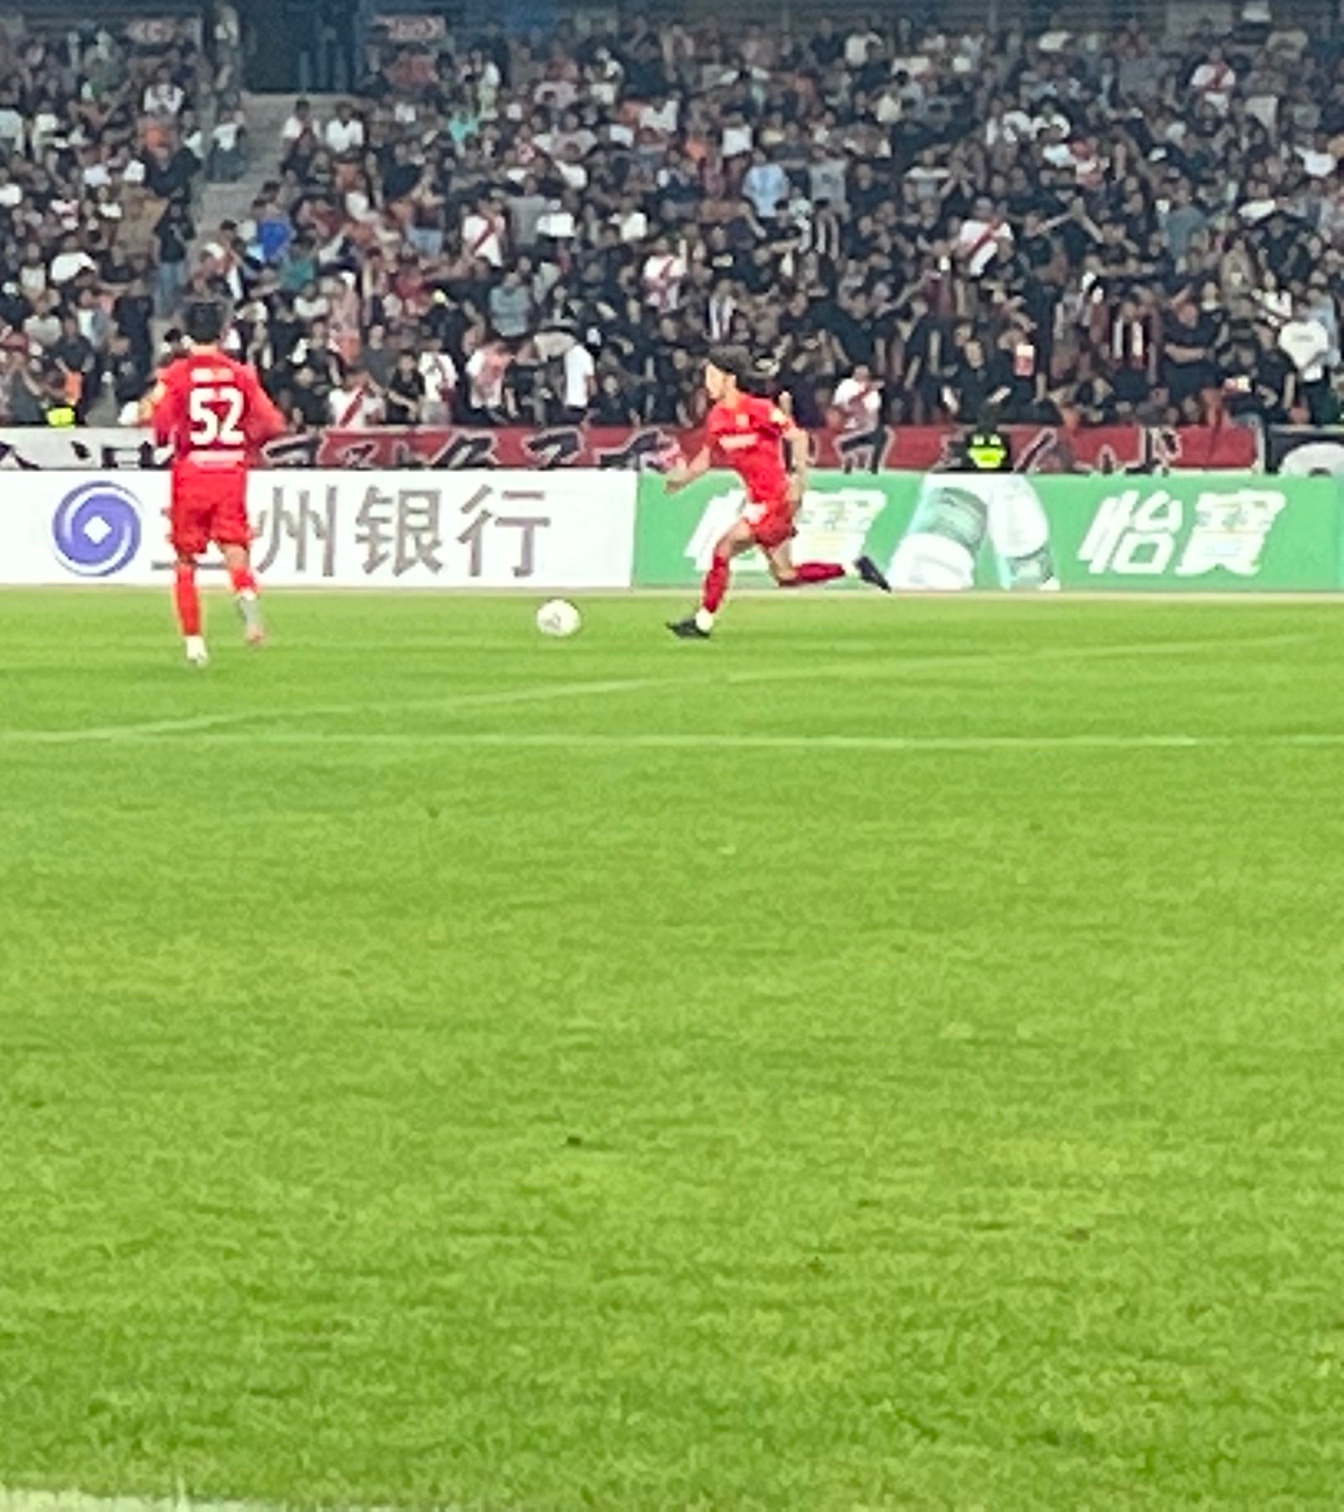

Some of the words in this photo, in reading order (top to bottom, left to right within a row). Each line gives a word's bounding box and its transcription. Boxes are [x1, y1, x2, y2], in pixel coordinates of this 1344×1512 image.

[189, 386, 245, 445] 52
[151, 484, 552, 578] 州银行
